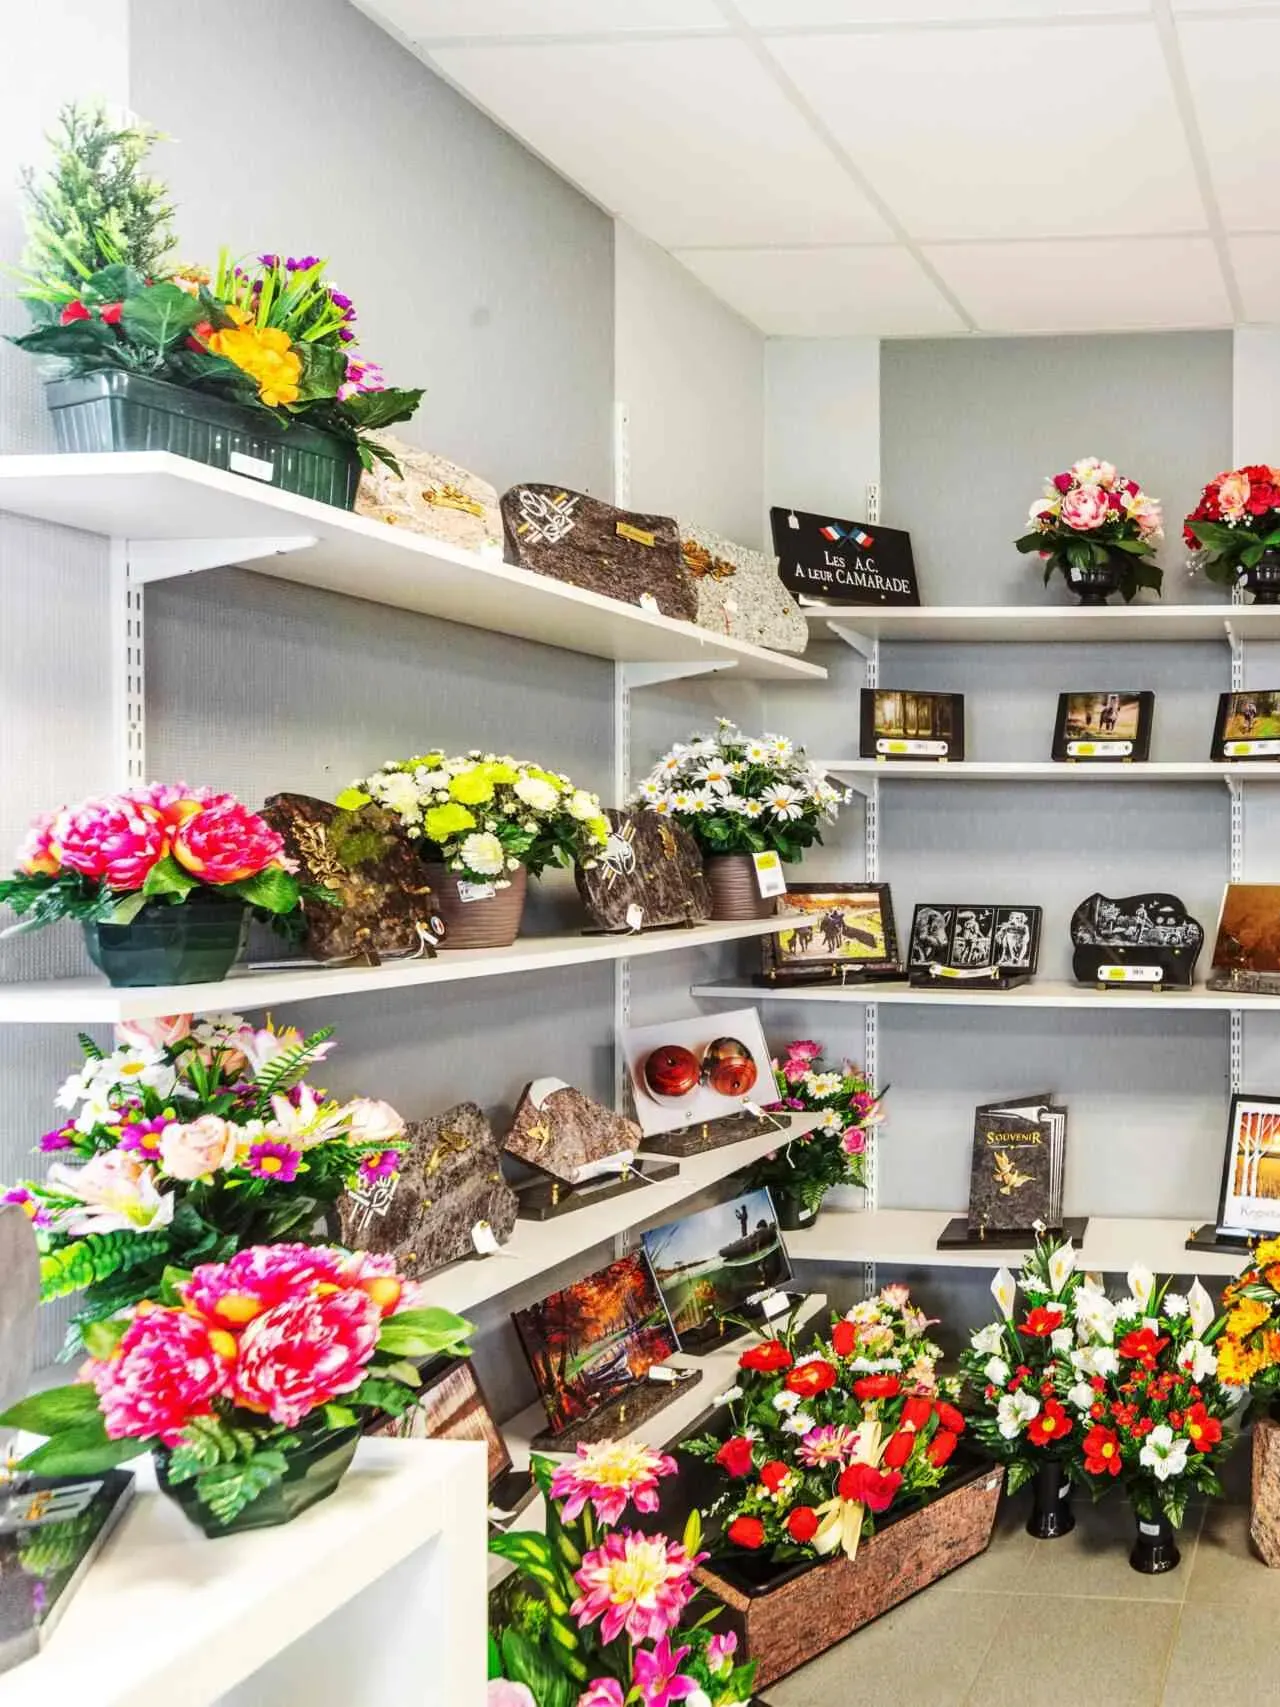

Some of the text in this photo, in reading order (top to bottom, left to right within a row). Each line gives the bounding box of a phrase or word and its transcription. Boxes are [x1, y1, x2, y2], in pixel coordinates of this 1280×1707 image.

[855, 557, 879, 573] A.C.
[795, 563, 805, 578] A
[835, 571, 911, 594] CAMARADE
[986, 1131, 1043, 1145] SOUVENIR
